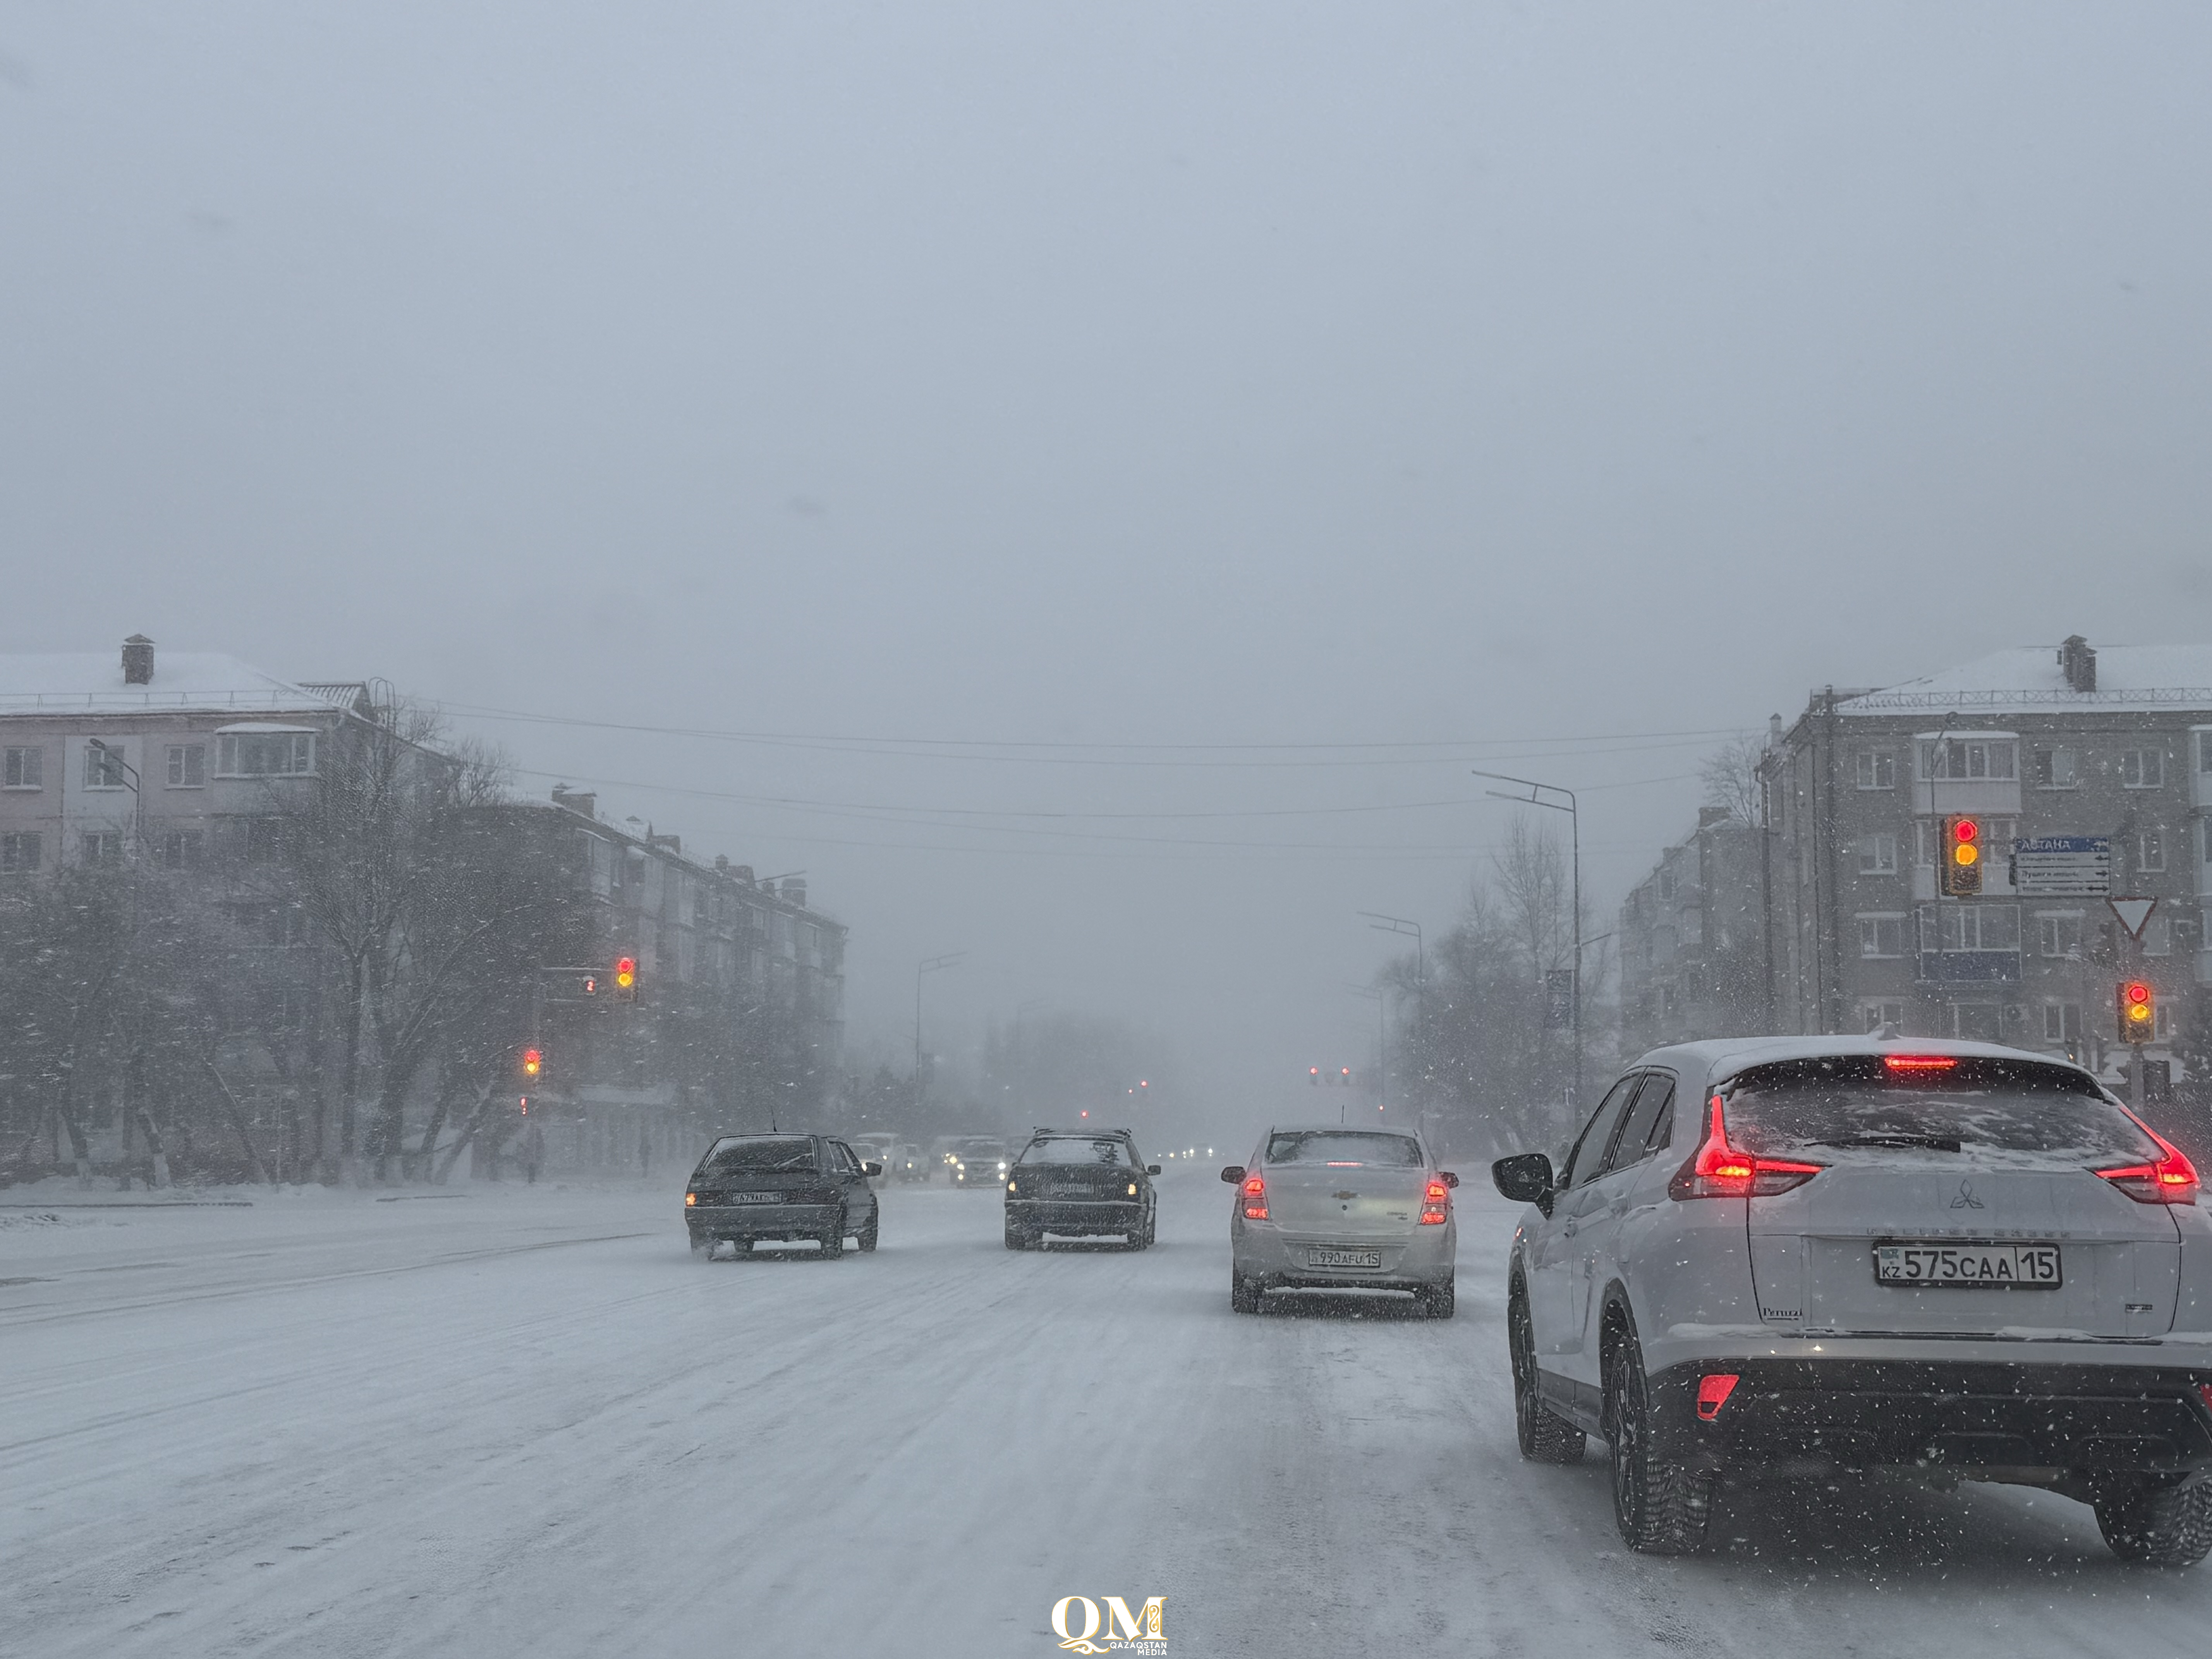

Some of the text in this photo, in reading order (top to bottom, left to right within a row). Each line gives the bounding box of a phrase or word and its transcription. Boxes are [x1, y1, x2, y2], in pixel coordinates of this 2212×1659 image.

[1366, 1253, 1378, 1264] 15
[1882, 1250, 2054, 1278] KZ 575CAA 15
